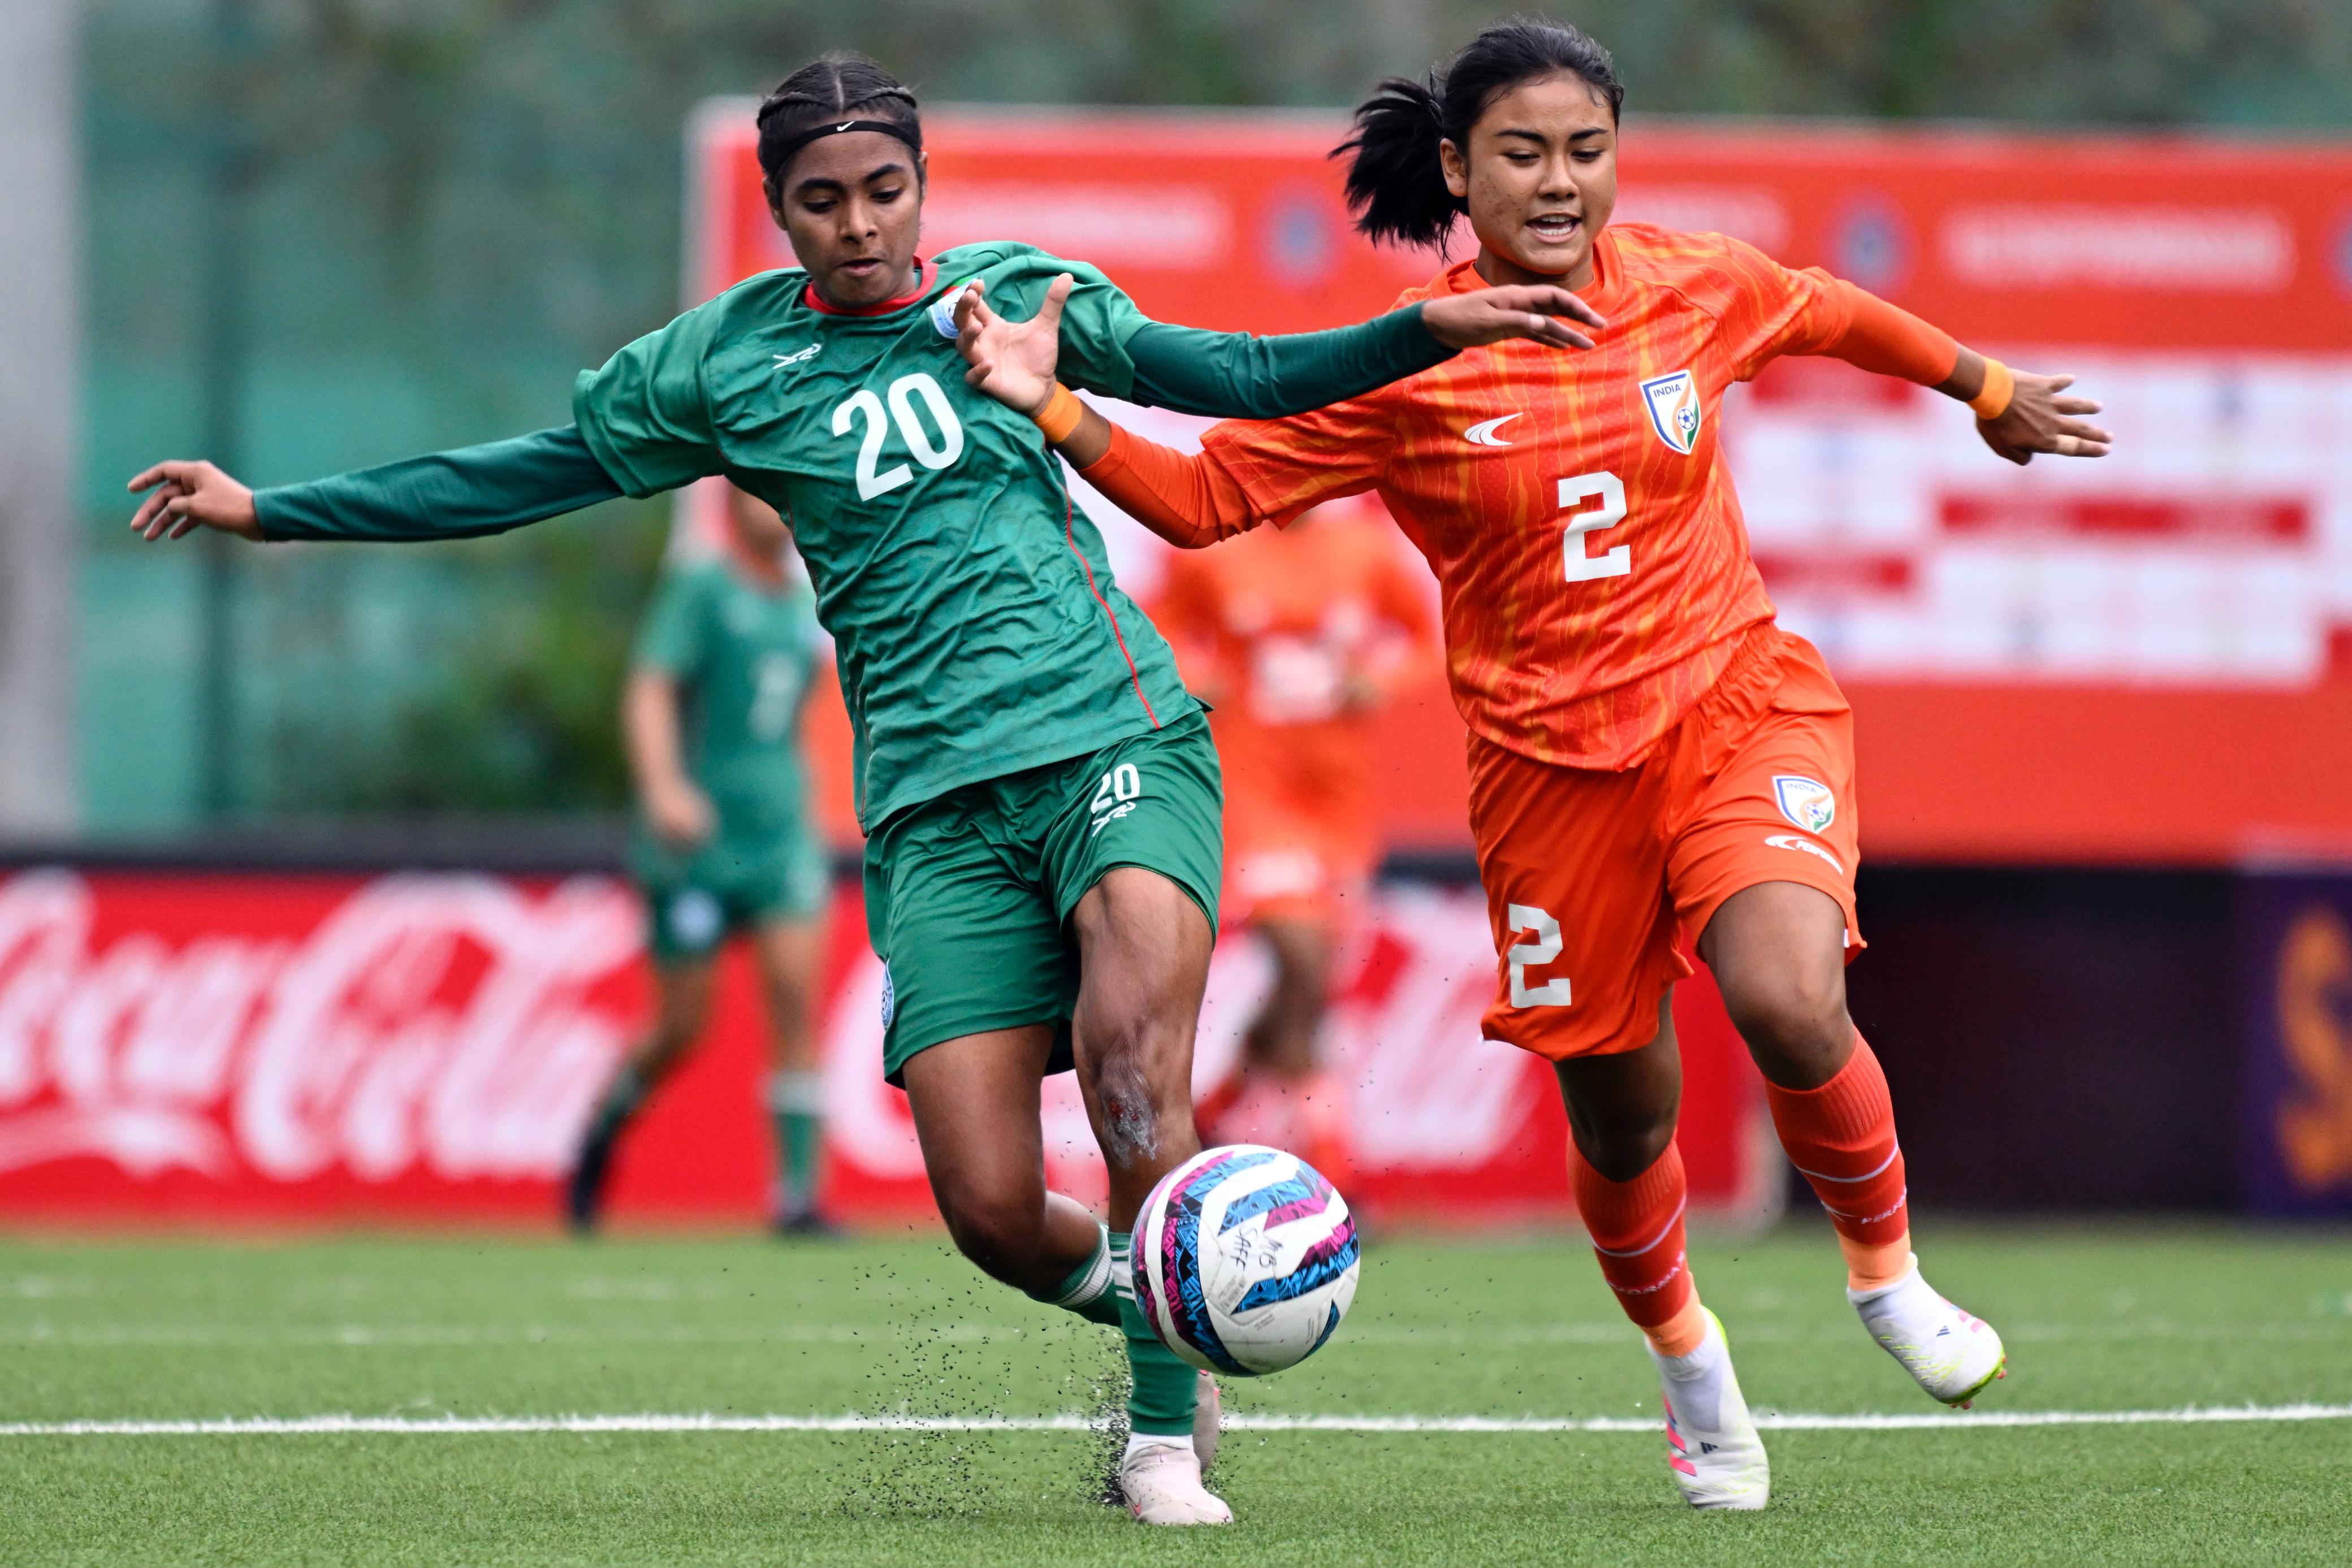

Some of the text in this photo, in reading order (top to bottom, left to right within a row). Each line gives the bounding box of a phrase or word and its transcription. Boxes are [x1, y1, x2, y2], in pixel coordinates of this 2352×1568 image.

[1653, 384, 1681, 397] INDIA
[832, 372, 964, 502] 20
[1558, 471, 1631, 582] 2
[1091, 764, 1140, 814] 20
[1787, 783, 1817, 793] INDIA
[1508, 903, 1572, 1008] 2
